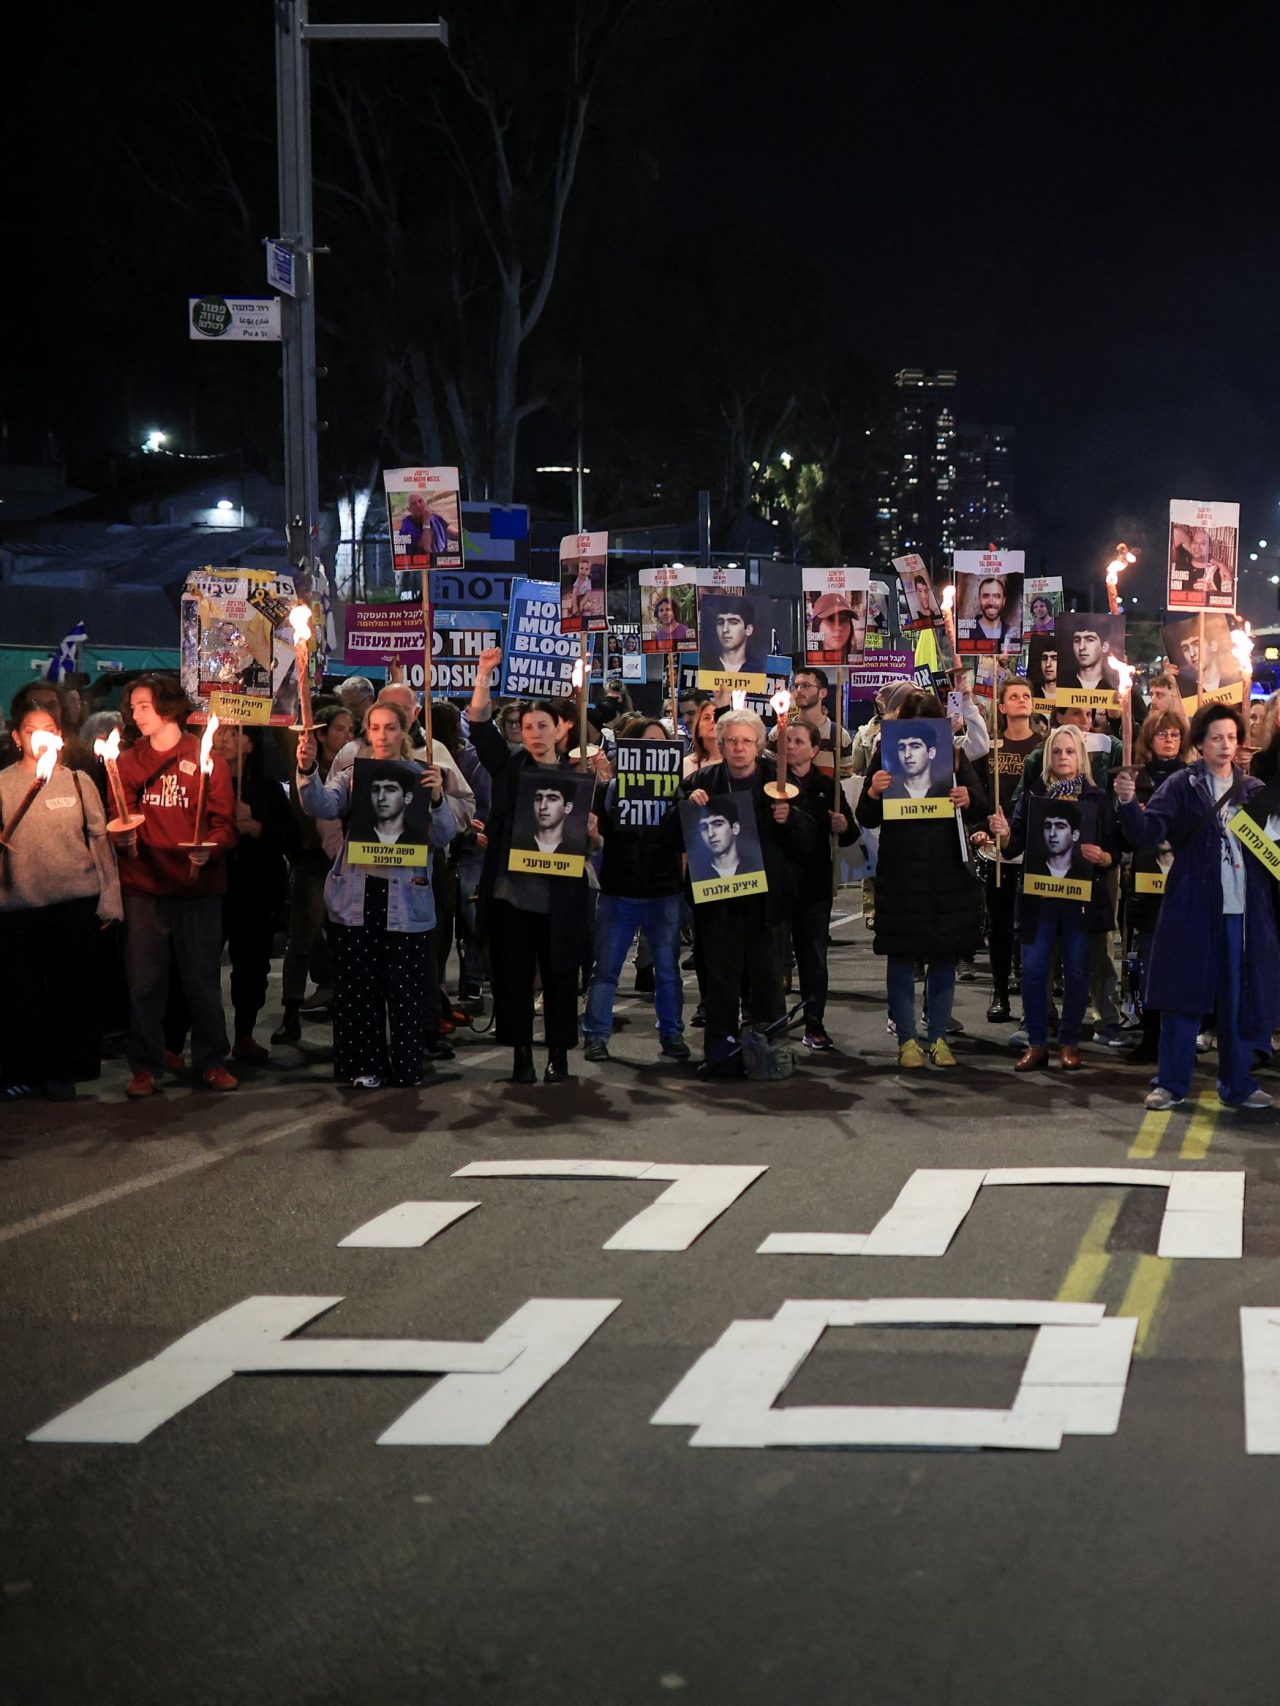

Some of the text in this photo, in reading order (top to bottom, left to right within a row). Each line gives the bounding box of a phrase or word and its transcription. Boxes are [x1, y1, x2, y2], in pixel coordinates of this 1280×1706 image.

[198, 582, 236, 598] שבויי
[404, 609, 424, 618] לקבל
[526, 600, 560, 618] HO
[357, 612, 388, 620] העסקה
[518, 616, 580, 639] MUC
[958, 619, 976, 630] BRING
[806, 631, 824, 642] BRING
[958, 630, 970, 639] HIM
[352, 634, 425, 648] לצאת מעזה!
[449, 632, 496, 656] THE
[515, 635, 582, 658] BLOOD
[806, 642, 819, 650] HER
[890, 655, 906, 663] לקבל
[508, 657, 574, 679] WILL B
[398, 664, 500, 687] LOODSHD
[714, 677, 750, 686] ירדן ביבס
[852, 674, 881, 685] מעזה!
[507, 675, 573, 698] SPILLED
[242, 701, 263, 710] תינוק
[1071, 694, 1108, 706] איתן הורן
[230, 708, 252, 717] בעזה
[618, 748, 680, 772] למה הם
[618, 772, 680, 798] עדיין
[618, 800, 667, 826] עזה?
[900, 804, 938, 816] יאיר הורן
[362, 846, 415, 856] סשה אלכסנדר
[1238, 824, 1280, 867] עופר קלדרון
[373, 856, 402, 864] טרופנוב
[522, 858, 570, 870] יוסי שרעבי
[702, 879, 758, 898] איציק אלגרט
[1034, 882, 1082, 896] מתן אנגרסט
[1152, 880, 1163, 889] לוי
